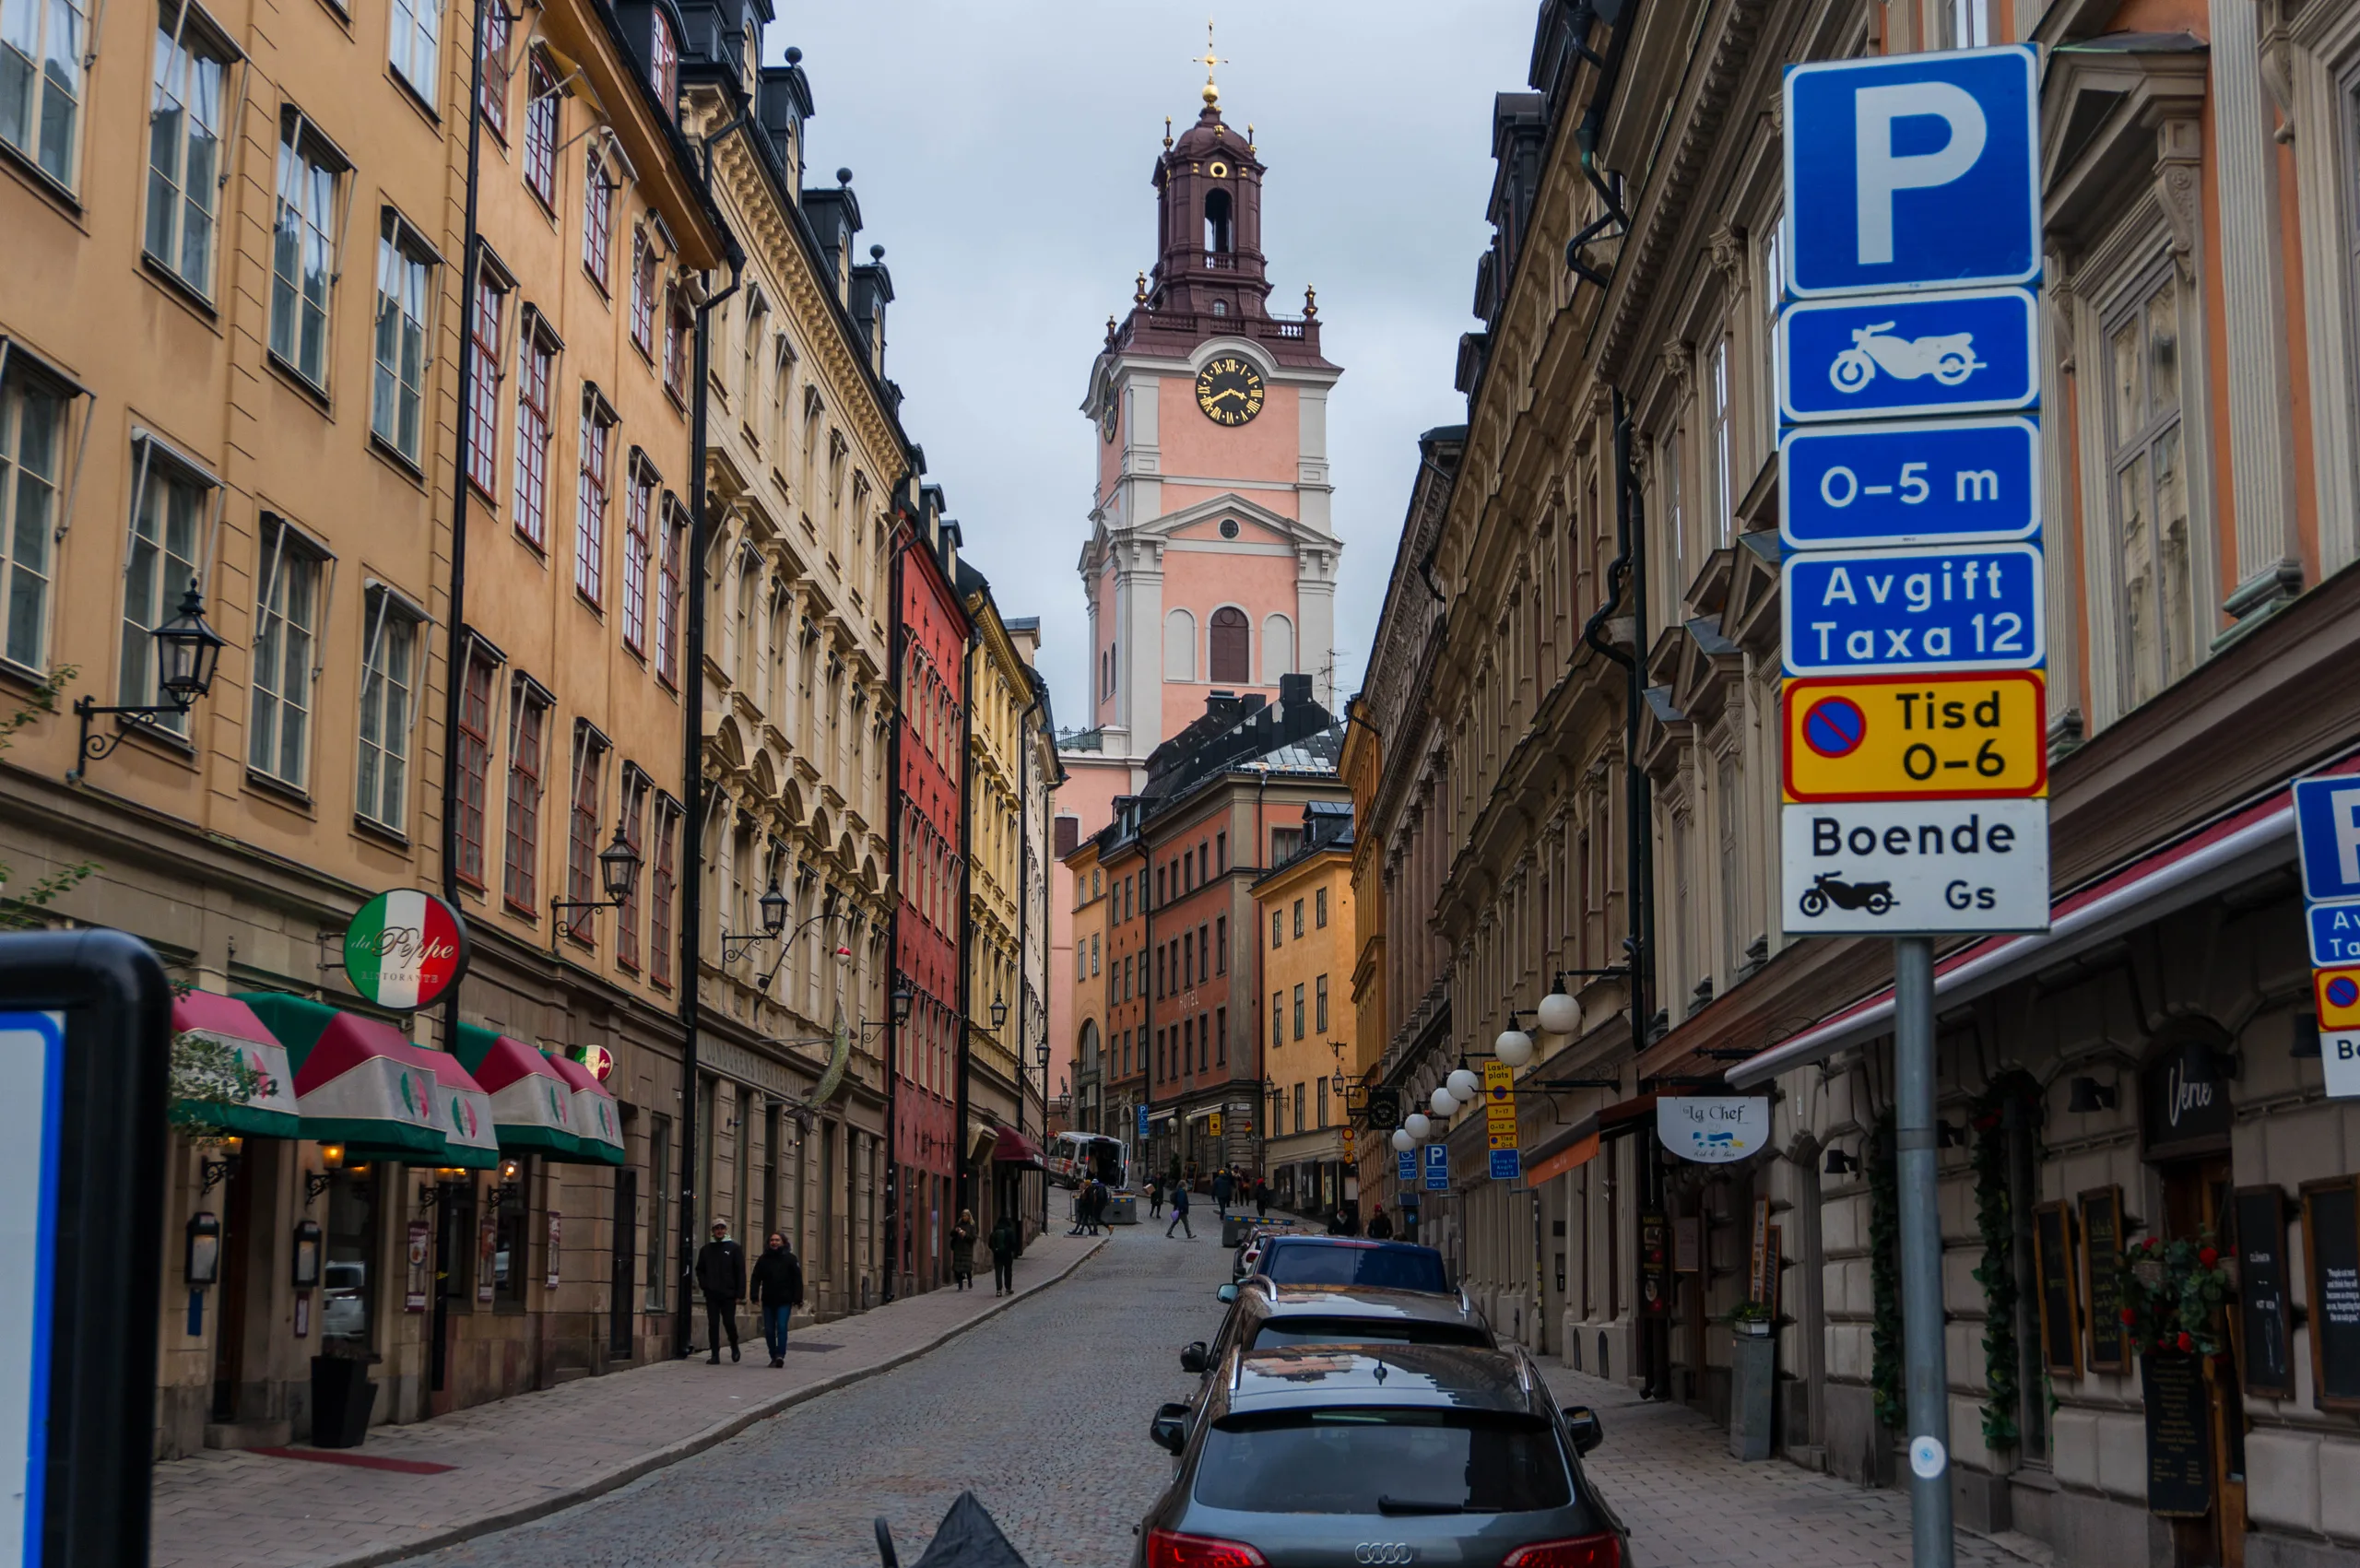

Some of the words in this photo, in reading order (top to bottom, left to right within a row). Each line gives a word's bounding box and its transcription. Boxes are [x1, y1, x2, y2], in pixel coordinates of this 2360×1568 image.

[1856, 81, 1987, 265] P
[1226, 359, 1235, 372] XII
[1956, 469, 1999, 501] m
[1823, 561, 2002, 612] Avgift
[1811, 621, 1952, 660] Taxa
[1971, 612, 2023, 652] 12
[1895, 690, 2000, 730] Tisd
[1812, 814, 2016, 856] Boende
[1945, 879, 1997, 910] Gs
[372, 925, 454, 970] Peppe
[360, 971, 439, 984] RISTORANTE
[1179, 988, 1198, 1011] HOTEL
[1488, 1072, 1509, 1080] plats
[1709, 1104, 1745, 1124] Chef
[1431, 1147, 1444, 1165] P
